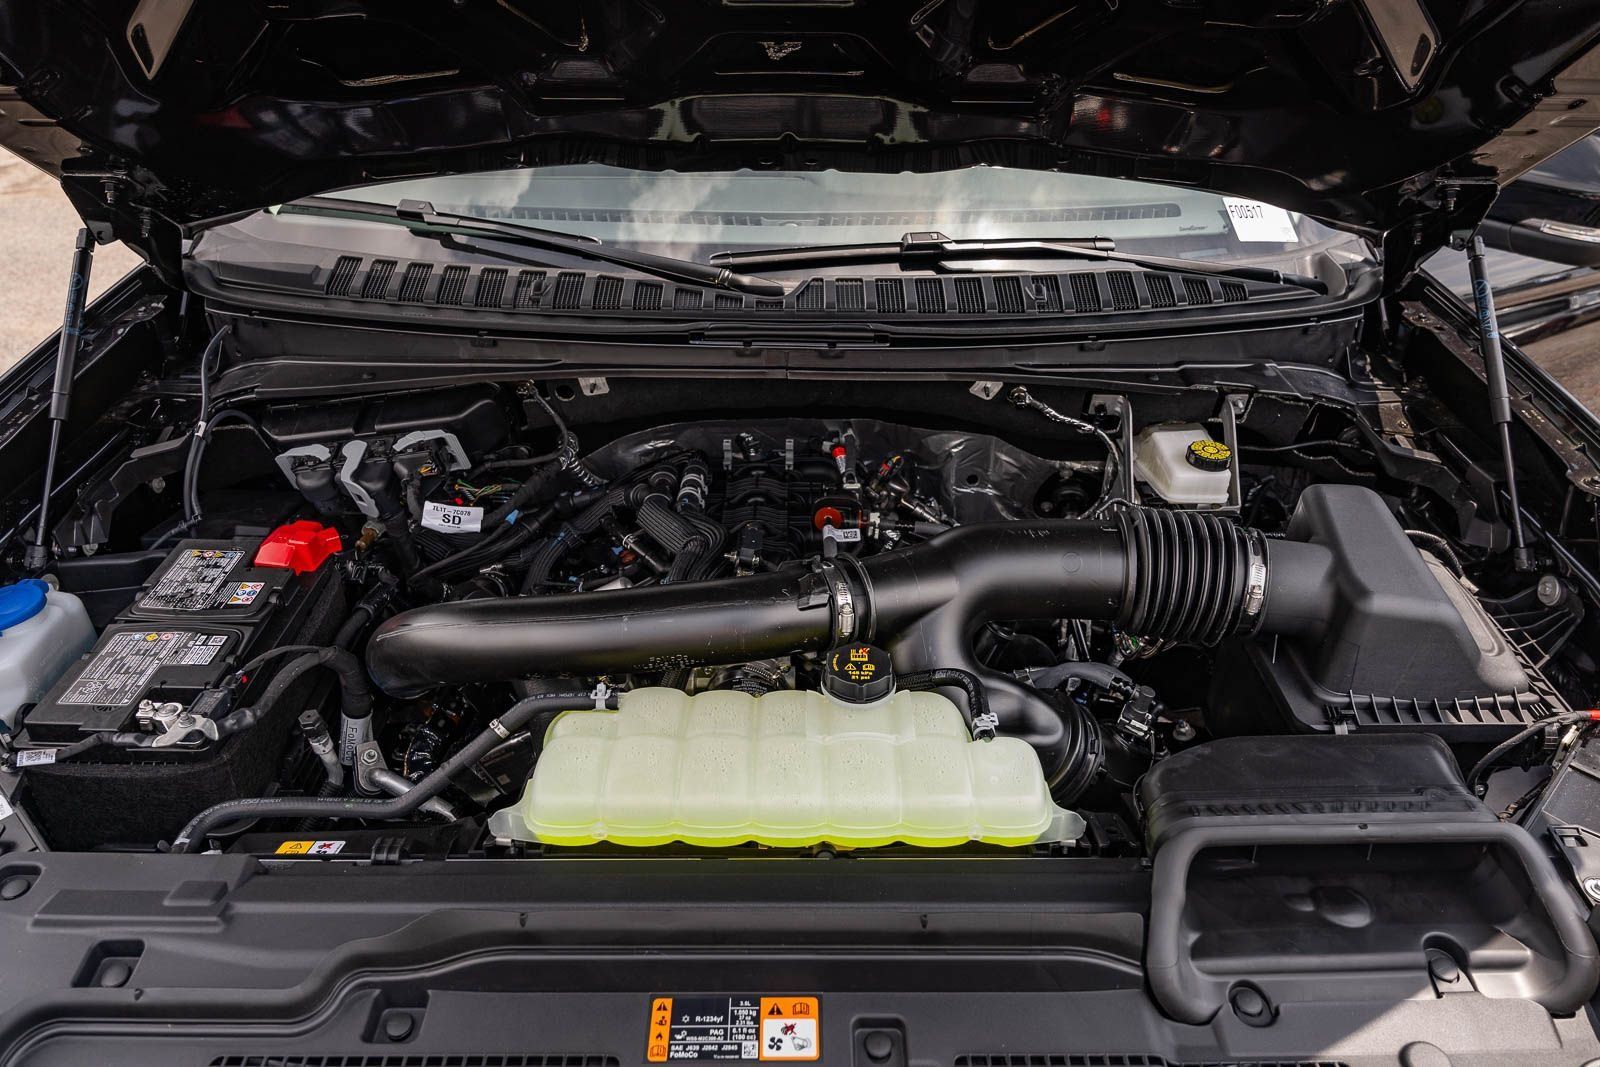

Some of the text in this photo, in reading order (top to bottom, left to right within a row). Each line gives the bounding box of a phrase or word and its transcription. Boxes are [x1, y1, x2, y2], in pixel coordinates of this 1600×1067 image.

[1228, 205, 1263, 219] F00517
[441, 513, 462, 526] SD
[345, 727, 357, 761] FoMoCo
[749, 1009, 757, 1017] kg
[695, 1015, 724, 1024] R-1234yf
[709, 1028, 724, 1036] PAG
[670, 1051, 698, 1059] FoMoCo
